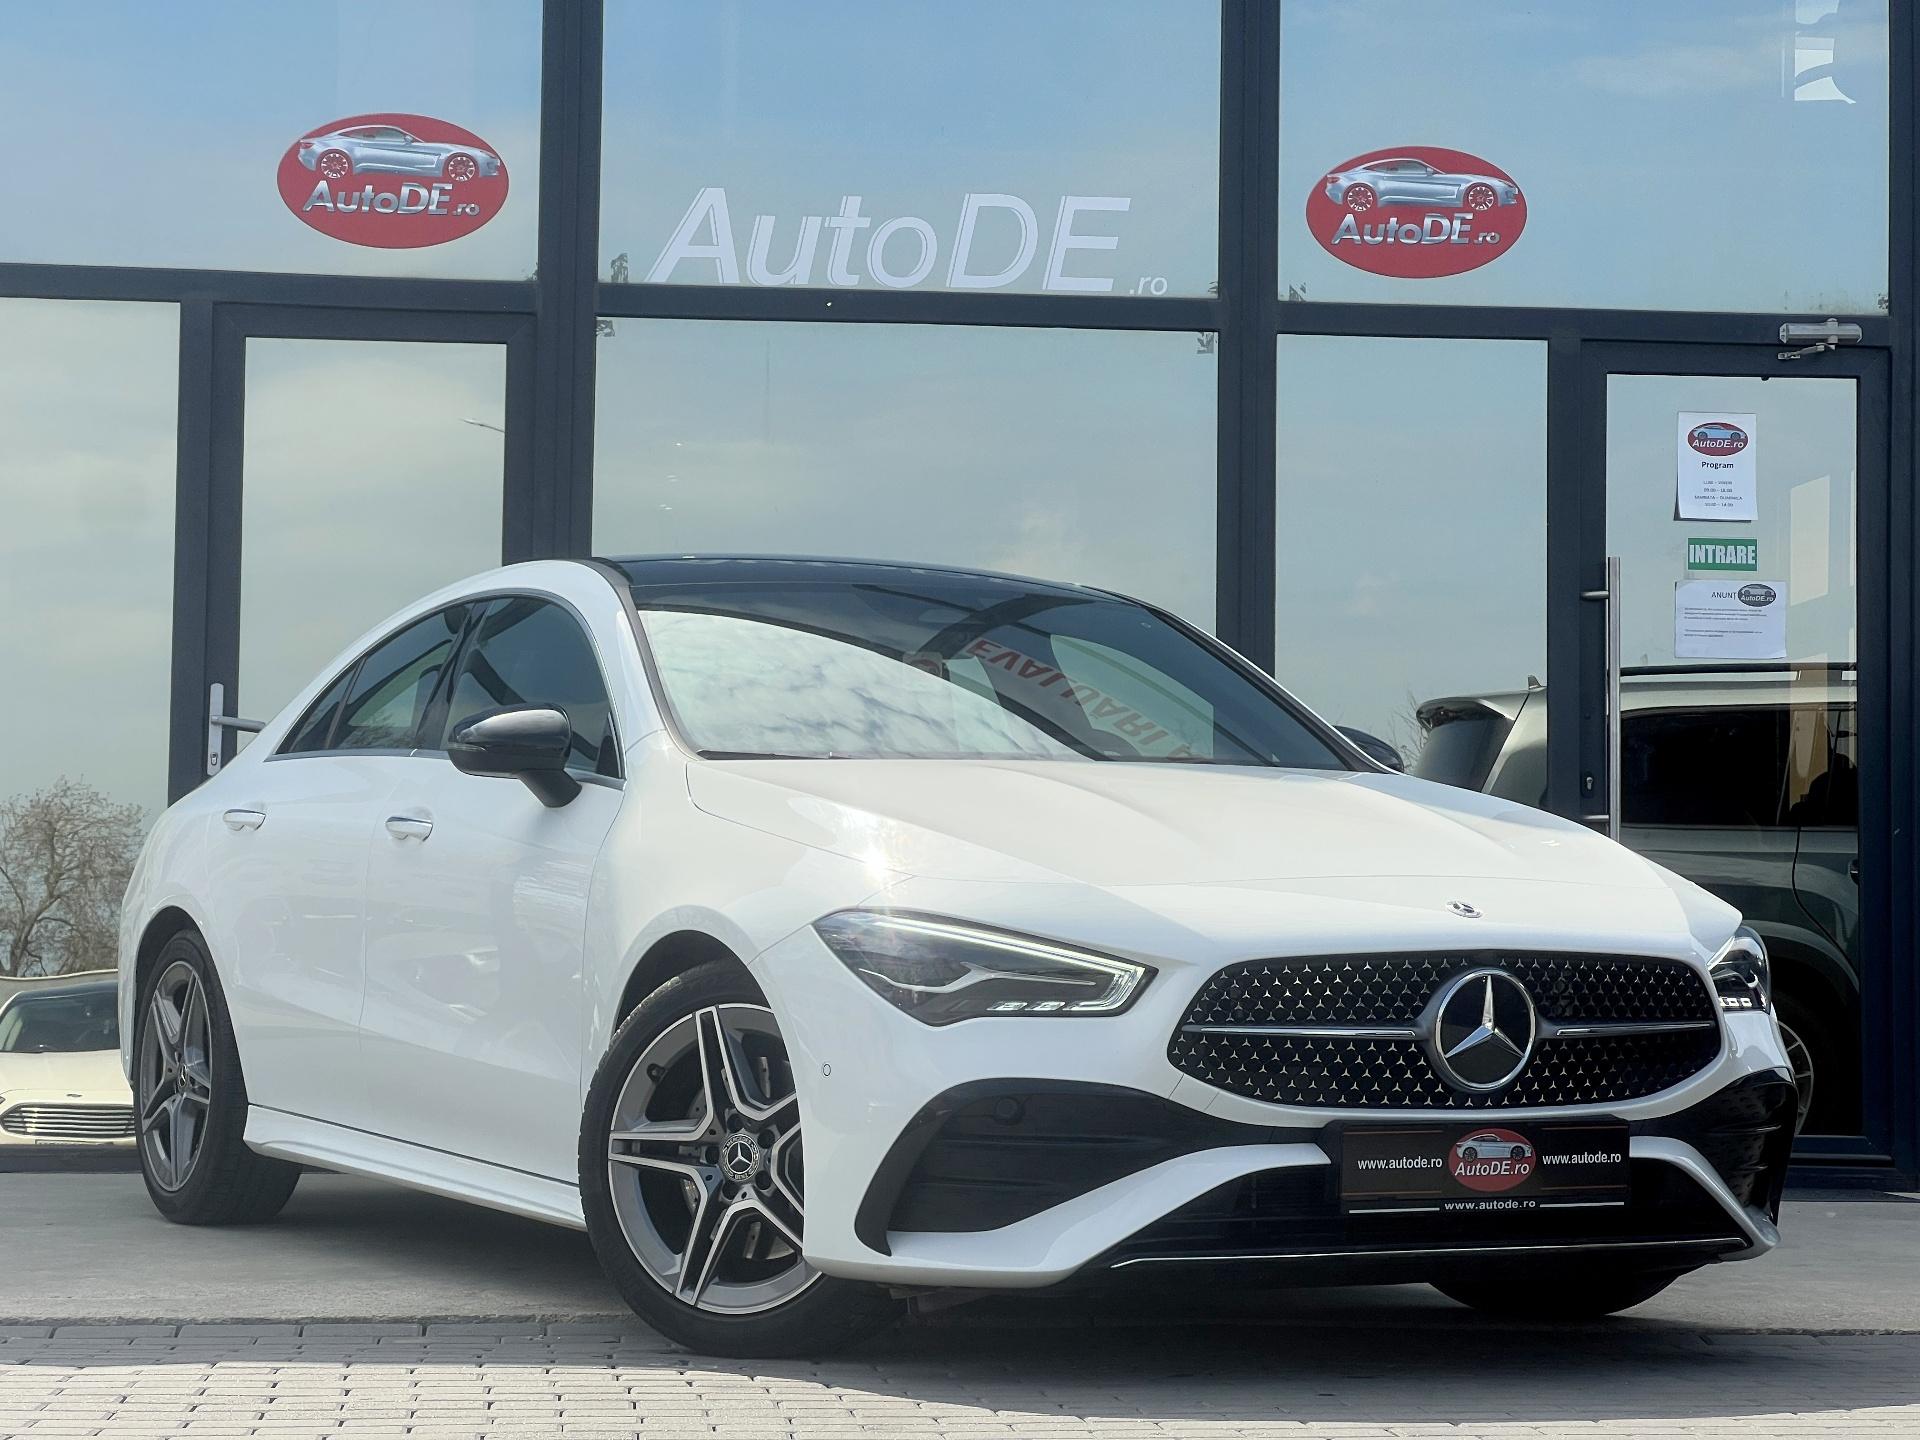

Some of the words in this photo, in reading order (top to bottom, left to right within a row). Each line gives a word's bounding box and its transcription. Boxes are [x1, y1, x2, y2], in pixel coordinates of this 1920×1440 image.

[1692, 439, 1744, 449] AutoDE.ro
[1701, 461, 1734, 470] Program
[1689, 544, 1756, 565] INTRARE
[1740, 594, 1774, 602] AutoDE.ro
[1357, 1155, 1443, 1170] www.autode.ro
[1542, 1151, 1622, 1165] www.autode.ro
[1454, 1160, 1530, 1177] AutoDE.ro
[1444, 1199, 1536, 1210] www.autode.ro
